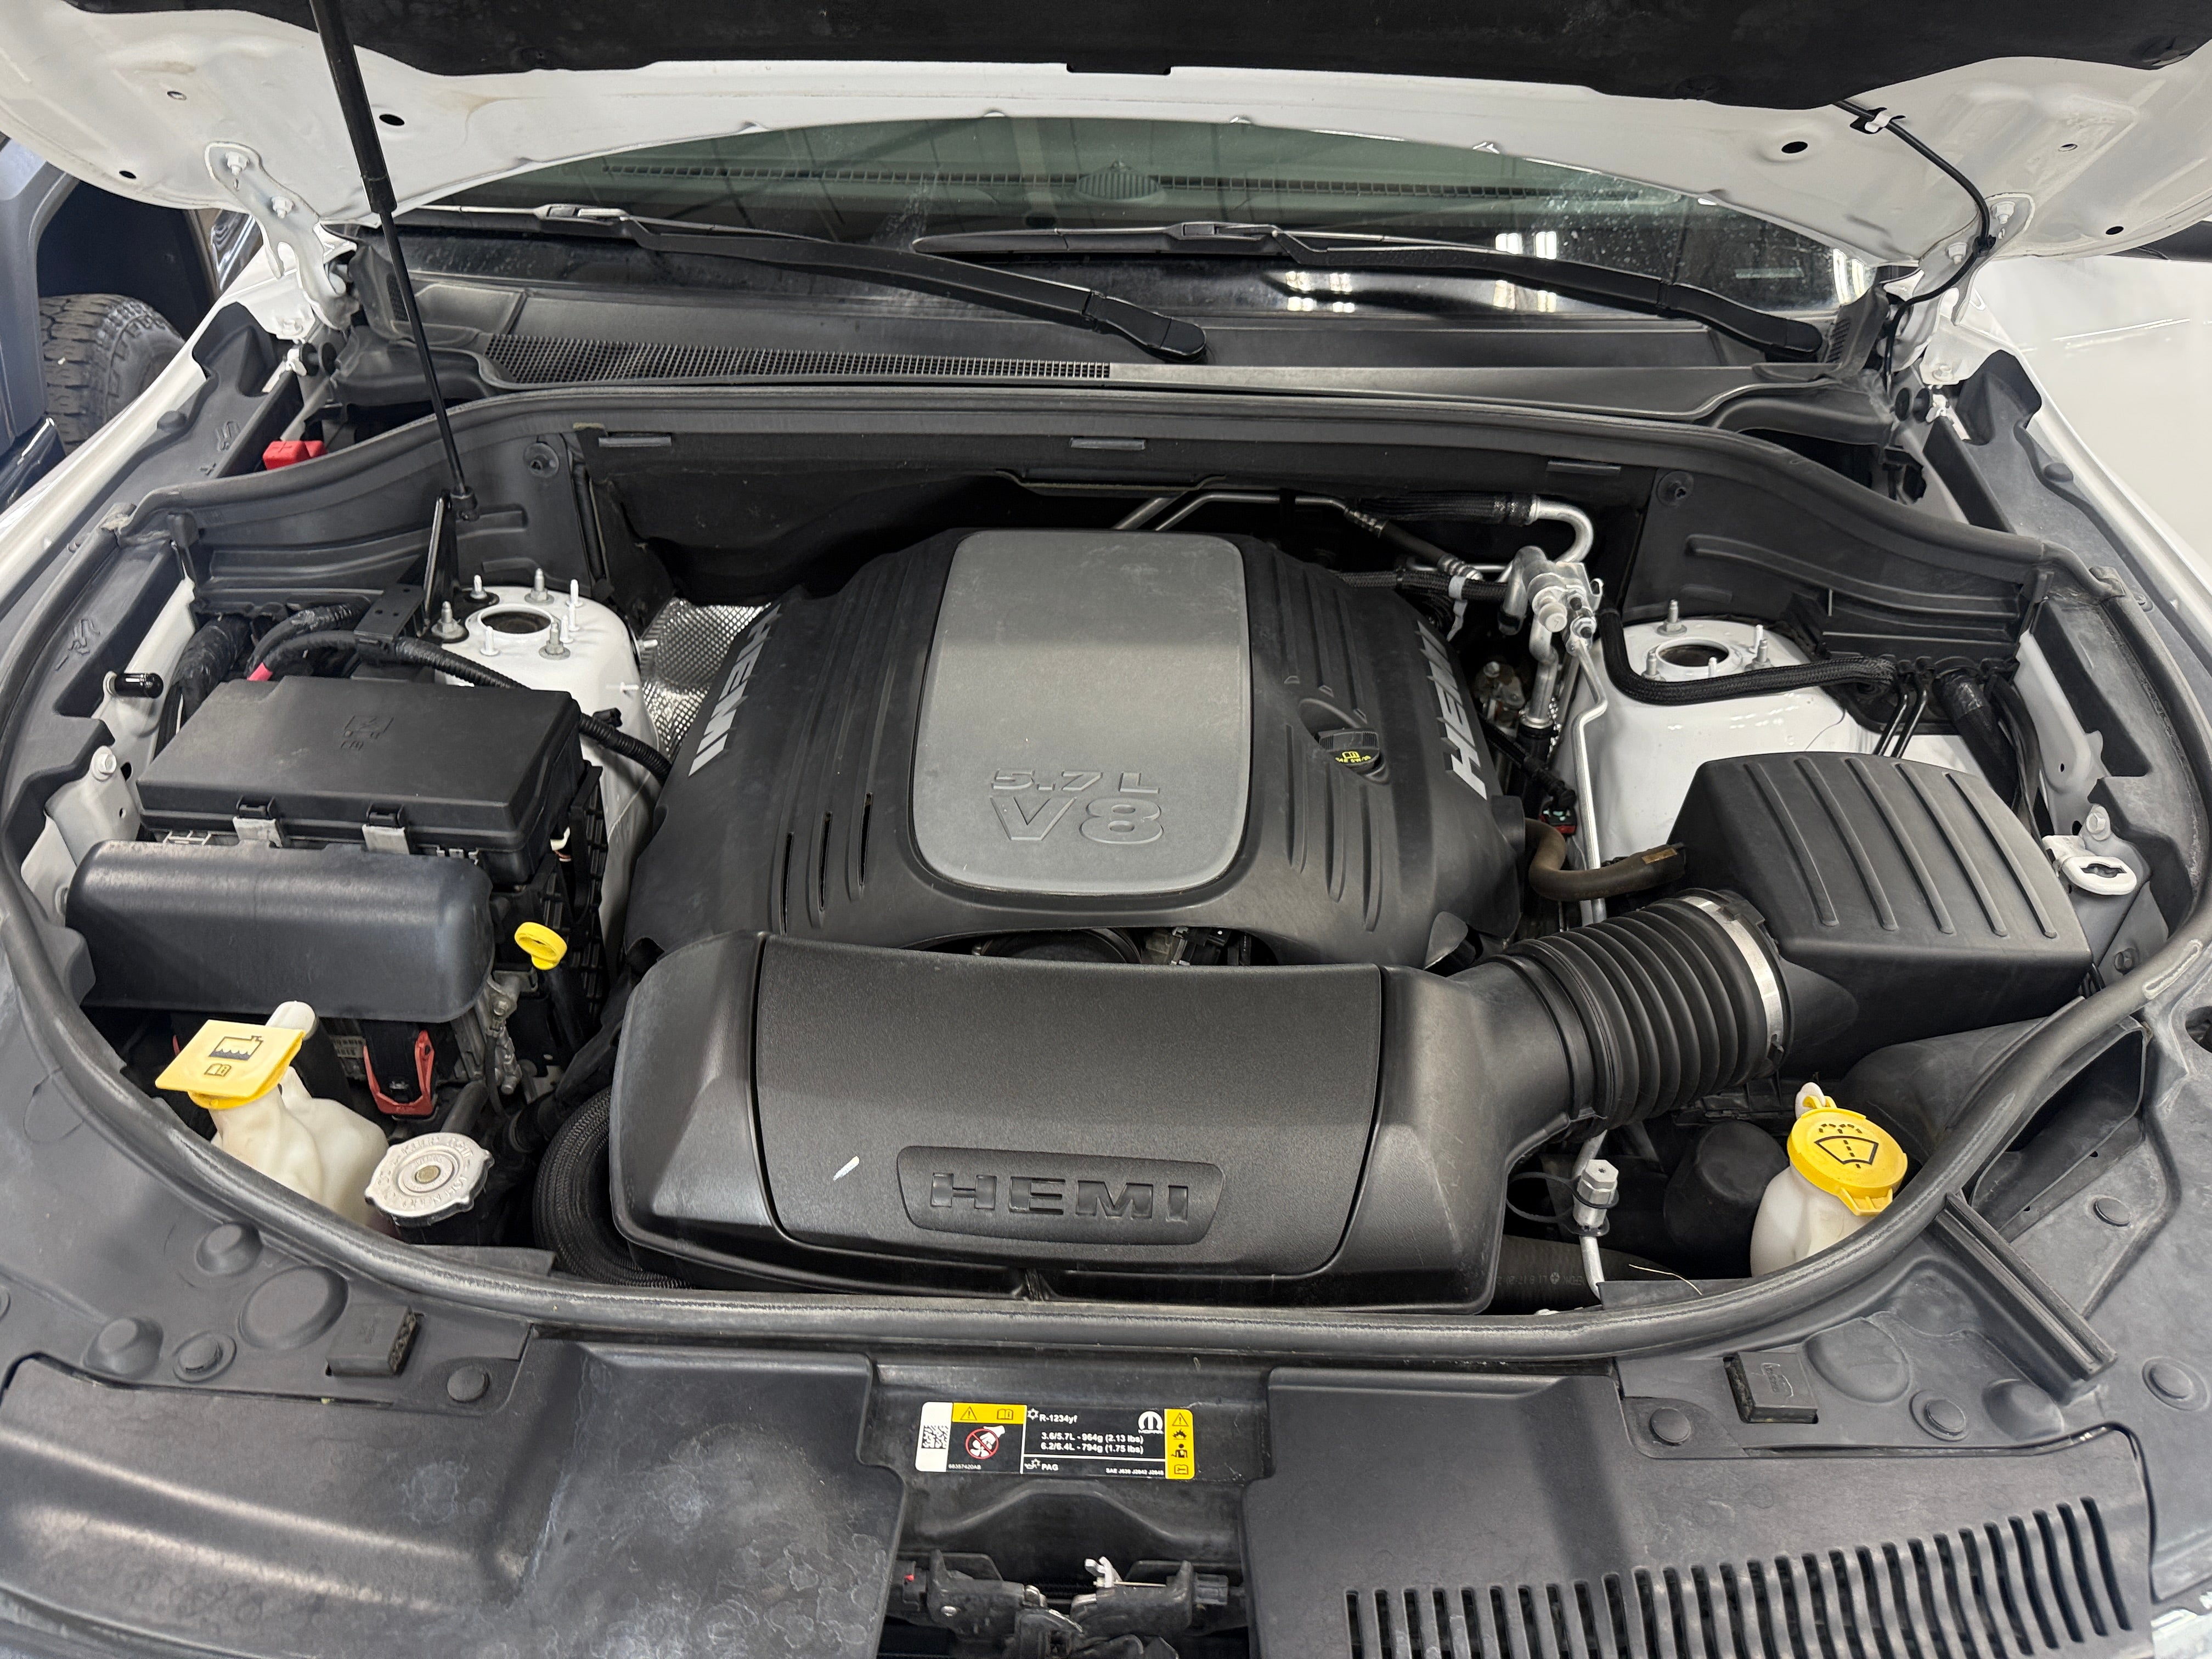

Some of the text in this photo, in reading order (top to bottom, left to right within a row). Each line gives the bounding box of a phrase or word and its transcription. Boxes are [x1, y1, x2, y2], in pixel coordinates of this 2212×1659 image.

[989, 795, 1165, 845] V8
[930, 1171, 1189, 1224] HEMI
[1039, 1414, 1077, 1424] R-1234yf
[1041, 1432, 1076, 1441] 3.6/5.7L
[1082, 1433, 1103, 1443] 964g
[1105, 1434, 1126, 1443] (2.13
[1127, 1435, 1144, 1444] lbs)
[1040, 1442, 1075, 1451] 6.2/6.4L
[1082, 1443, 1103, 1453] 794g
[1105, 1444, 1126, 1453] (1.75
[1127, 1444, 1144, 1454] lbs)
